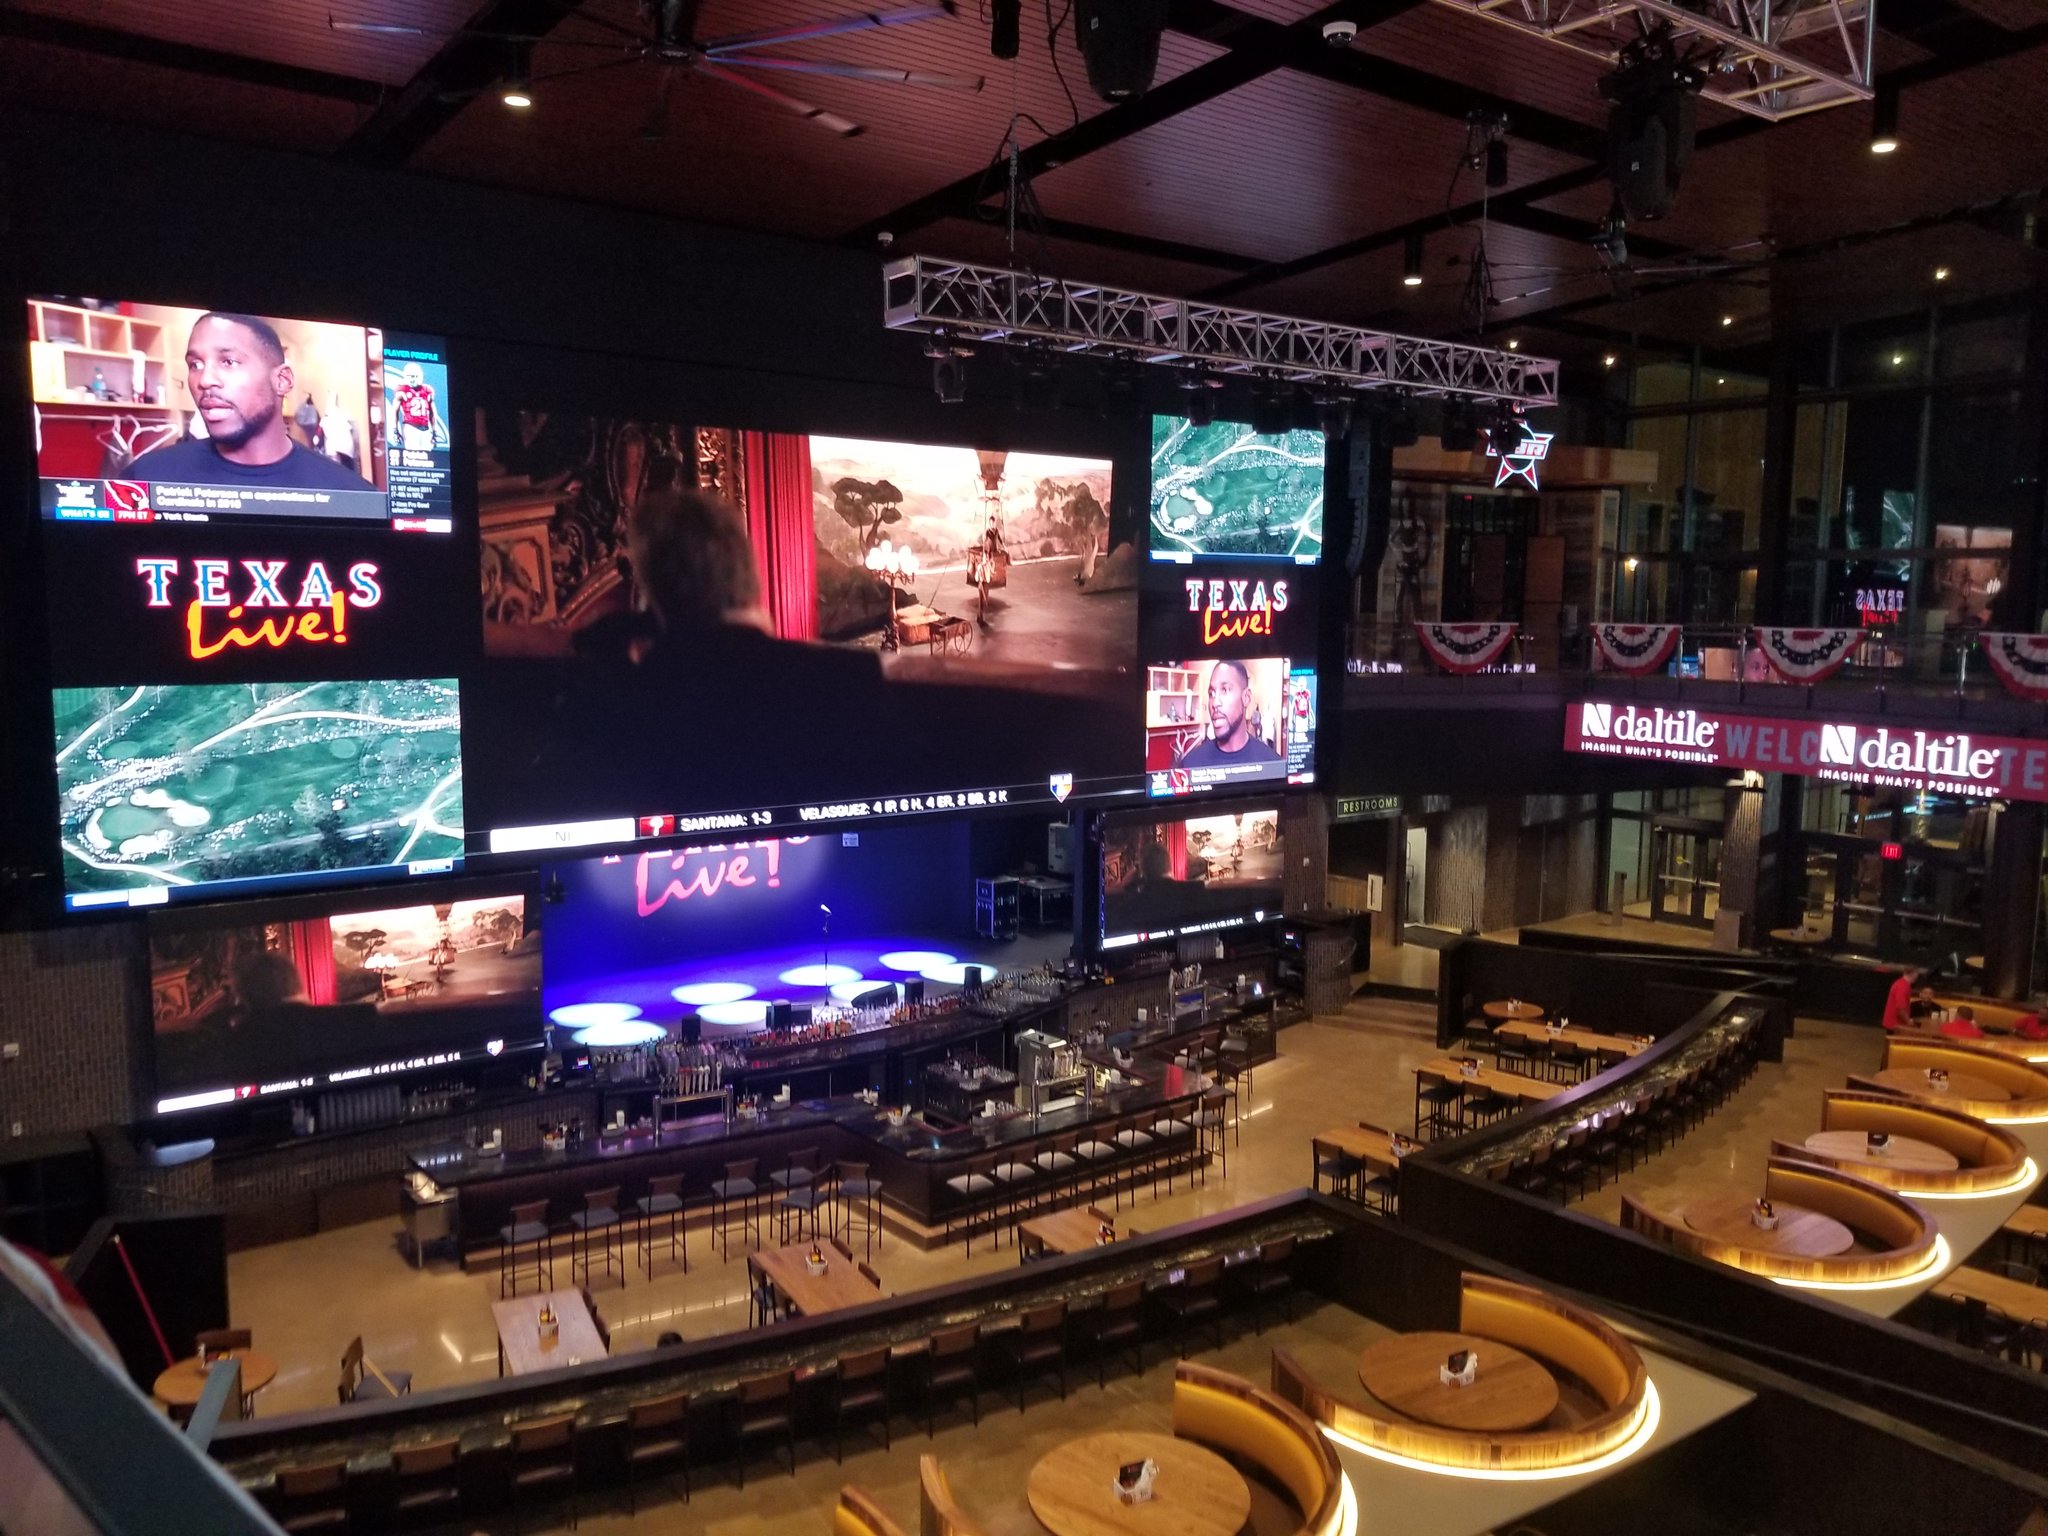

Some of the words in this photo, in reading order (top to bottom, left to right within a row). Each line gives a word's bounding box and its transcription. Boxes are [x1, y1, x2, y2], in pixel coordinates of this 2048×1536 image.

[384, 348, 410, 359] PLAYER
[411, 351, 438, 361] PROFILE
[137, 558, 381, 608] TEXAS
[1186, 580, 1287, 611] TEXAS
[187, 590, 347, 659] Live!
[1204, 597, 1271, 645] Live!
[1614, 705, 1716, 748] daltile
[1581, 741, 1621, 753] IMAGINE
[1625, 745, 1662, 758] WHAT'S
[1860, 729, 1996, 779] daltile
[1818, 769, 1870, 783] IMAGINE
[1874, 774, 1923, 790] WHAT'S
[799, 803, 870, 821] VELASQUEZ:
[873, 801, 882, 813] 4
[926, 796, 935, 808] 4
[936, 794, 955, 808] ER,
[957, 794, 966, 806] 2
[998, 790, 1008, 802] K
[1343, 797, 1398, 813] RESTROOMS
[680, 814, 748, 832] SANTANA:
[751, 810, 772, 826] 1-3
[636, 840, 780, 917] Live!
